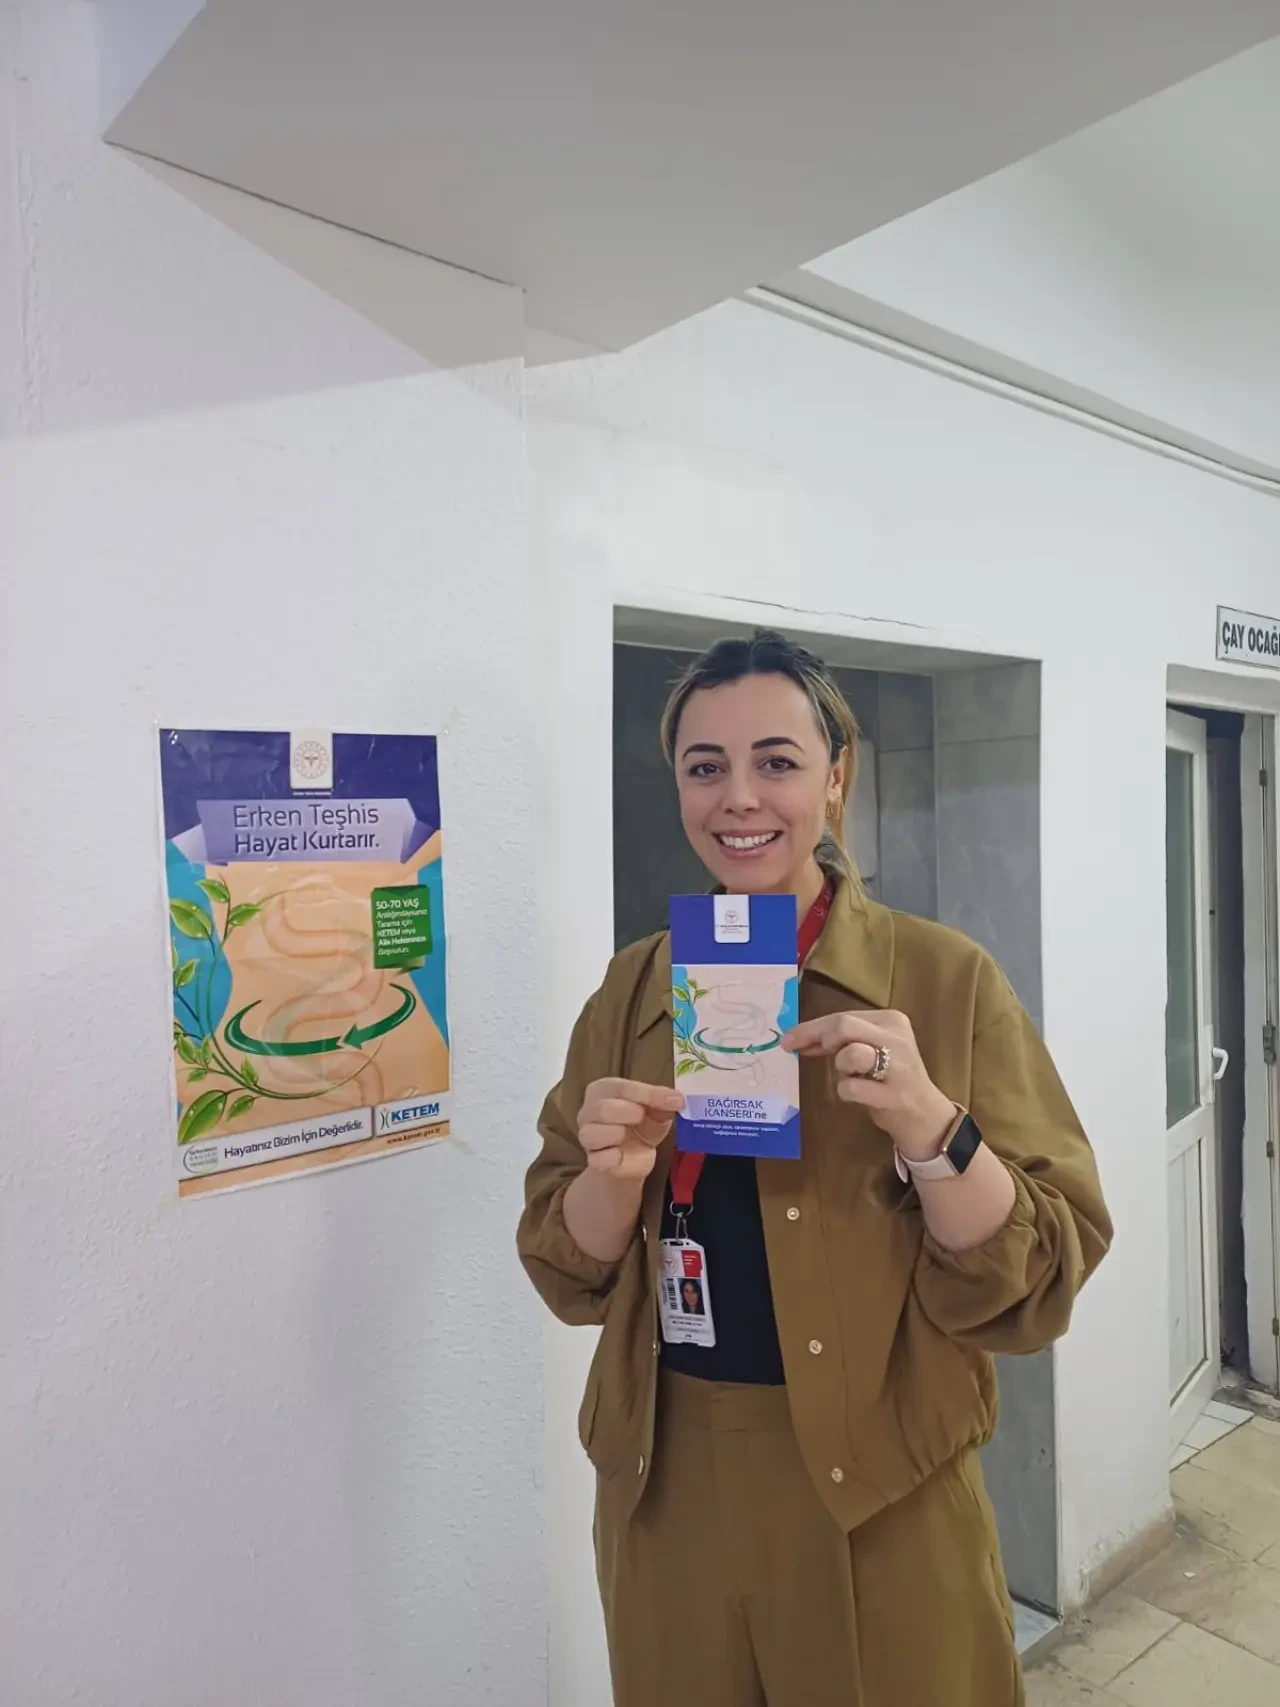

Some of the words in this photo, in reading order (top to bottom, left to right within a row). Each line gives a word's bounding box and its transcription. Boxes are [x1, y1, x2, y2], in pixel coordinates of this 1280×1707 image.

[1222, 621, 1245, 654] ÇAY
[233, 804, 302, 828] Erken
[308, 802, 379, 832] Teşhis
[234, 832, 298, 857] Hayat
[302, 830, 380, 852] Kurtarır.
[376, 900, 401, 910] 50-70
[402, 898, 419, 909] YAŞ
[377, 928, 401, 937] KETEM
[391, 1102, 440, 1122] KETEM
[707, 1097, 764, 1109] BAĞIRSAK
[224, 1140, 272, 1159] Hayatınız
[273, 1135, 301, 1148] Bizim
[301, 1128, 318, 1144] İçin
